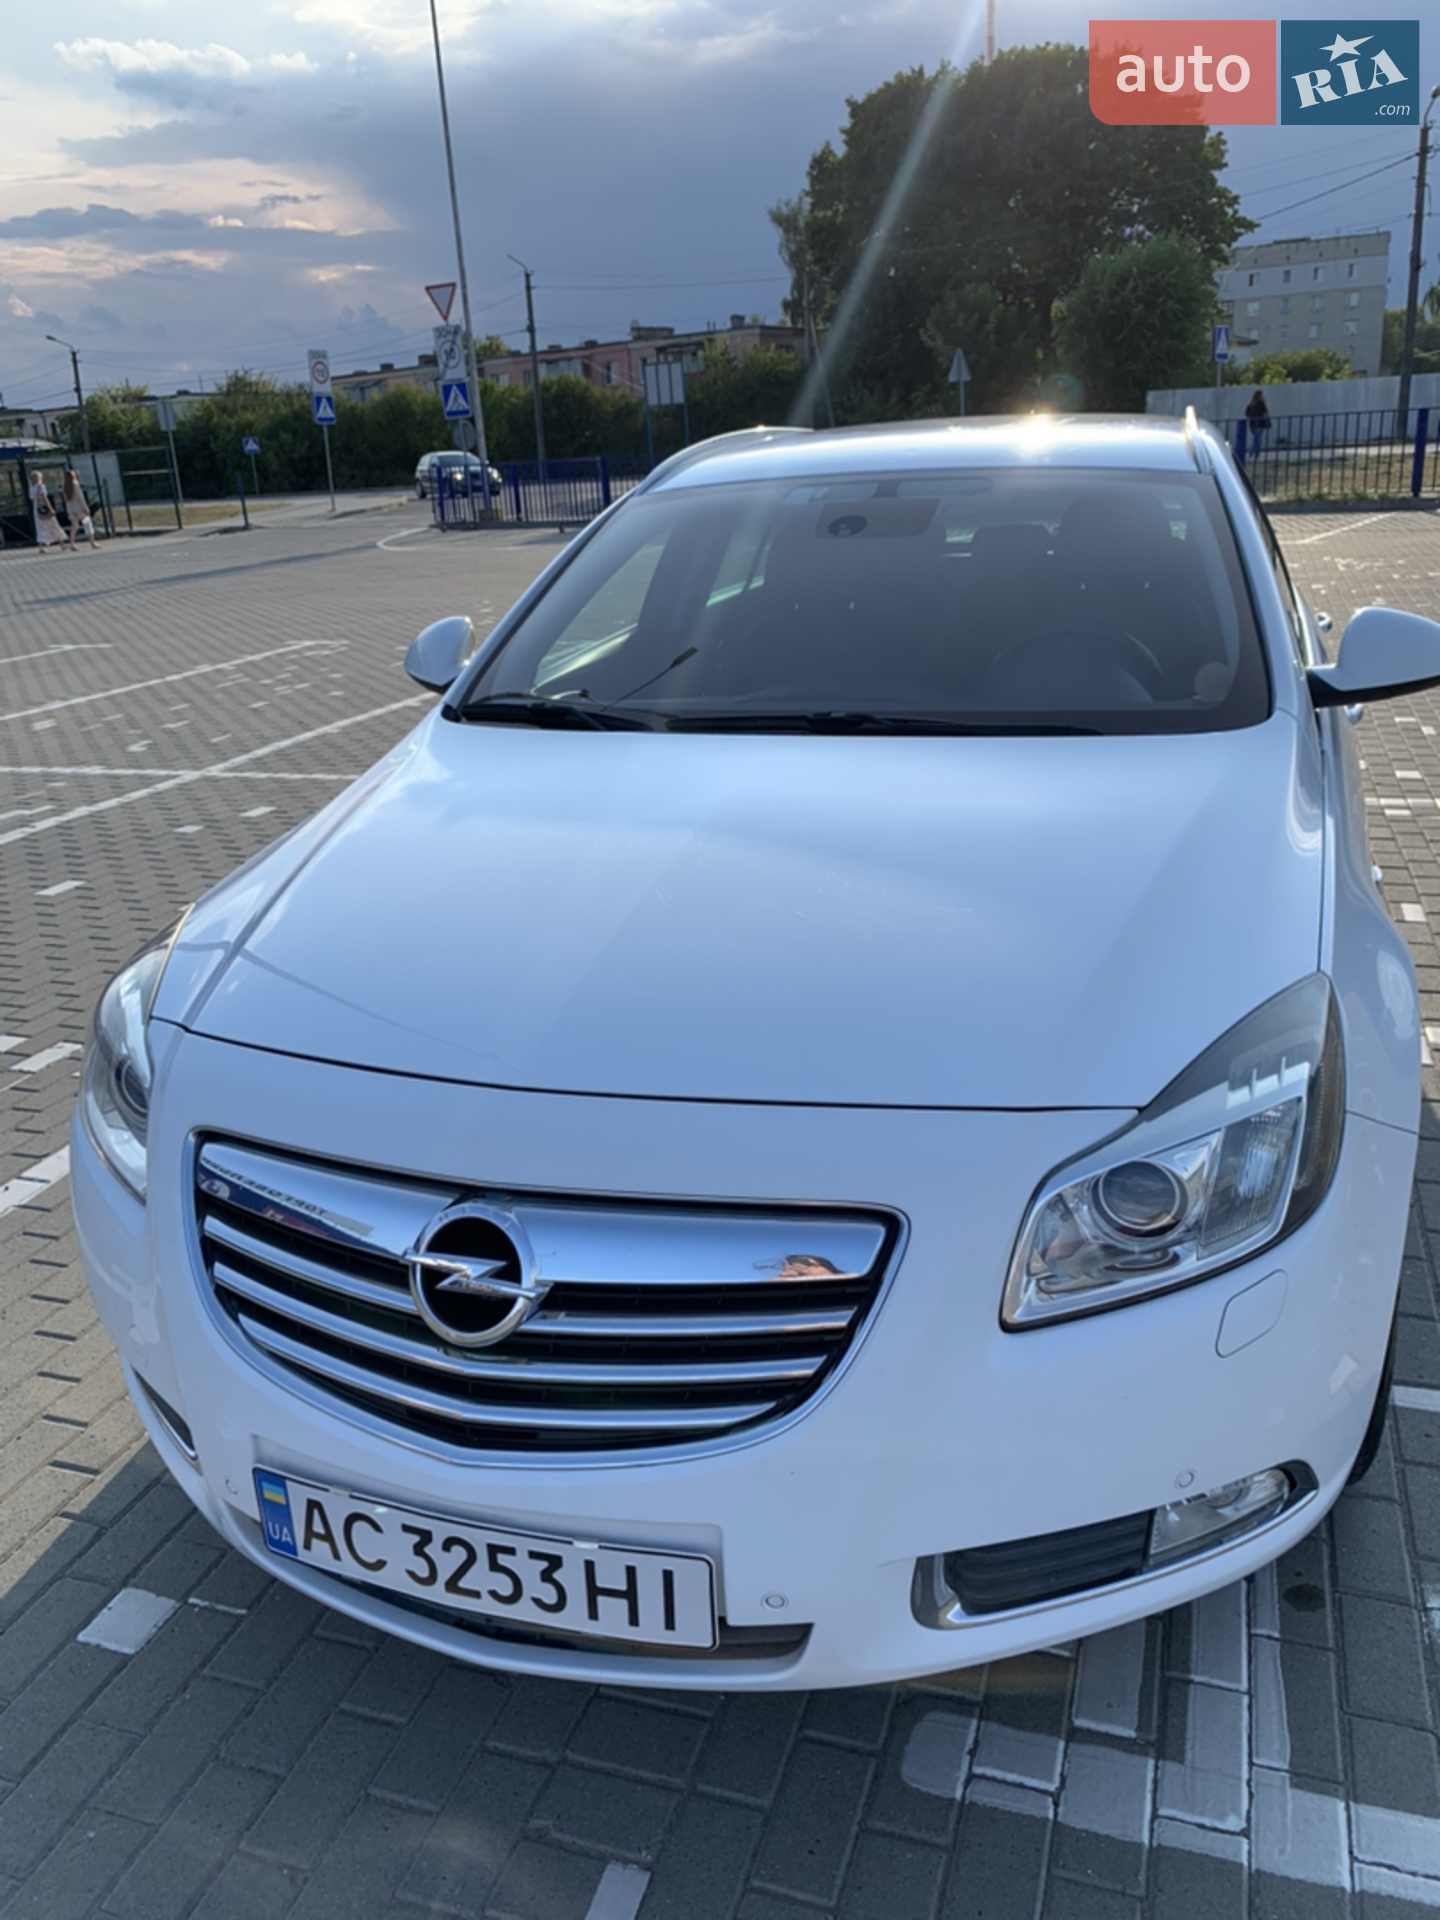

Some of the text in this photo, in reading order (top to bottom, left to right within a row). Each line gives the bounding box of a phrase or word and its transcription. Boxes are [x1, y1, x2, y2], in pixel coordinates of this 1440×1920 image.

[268, 1521, 294, 1546] UA
[303, 1498, 676, 1632] AC 3253 HI
